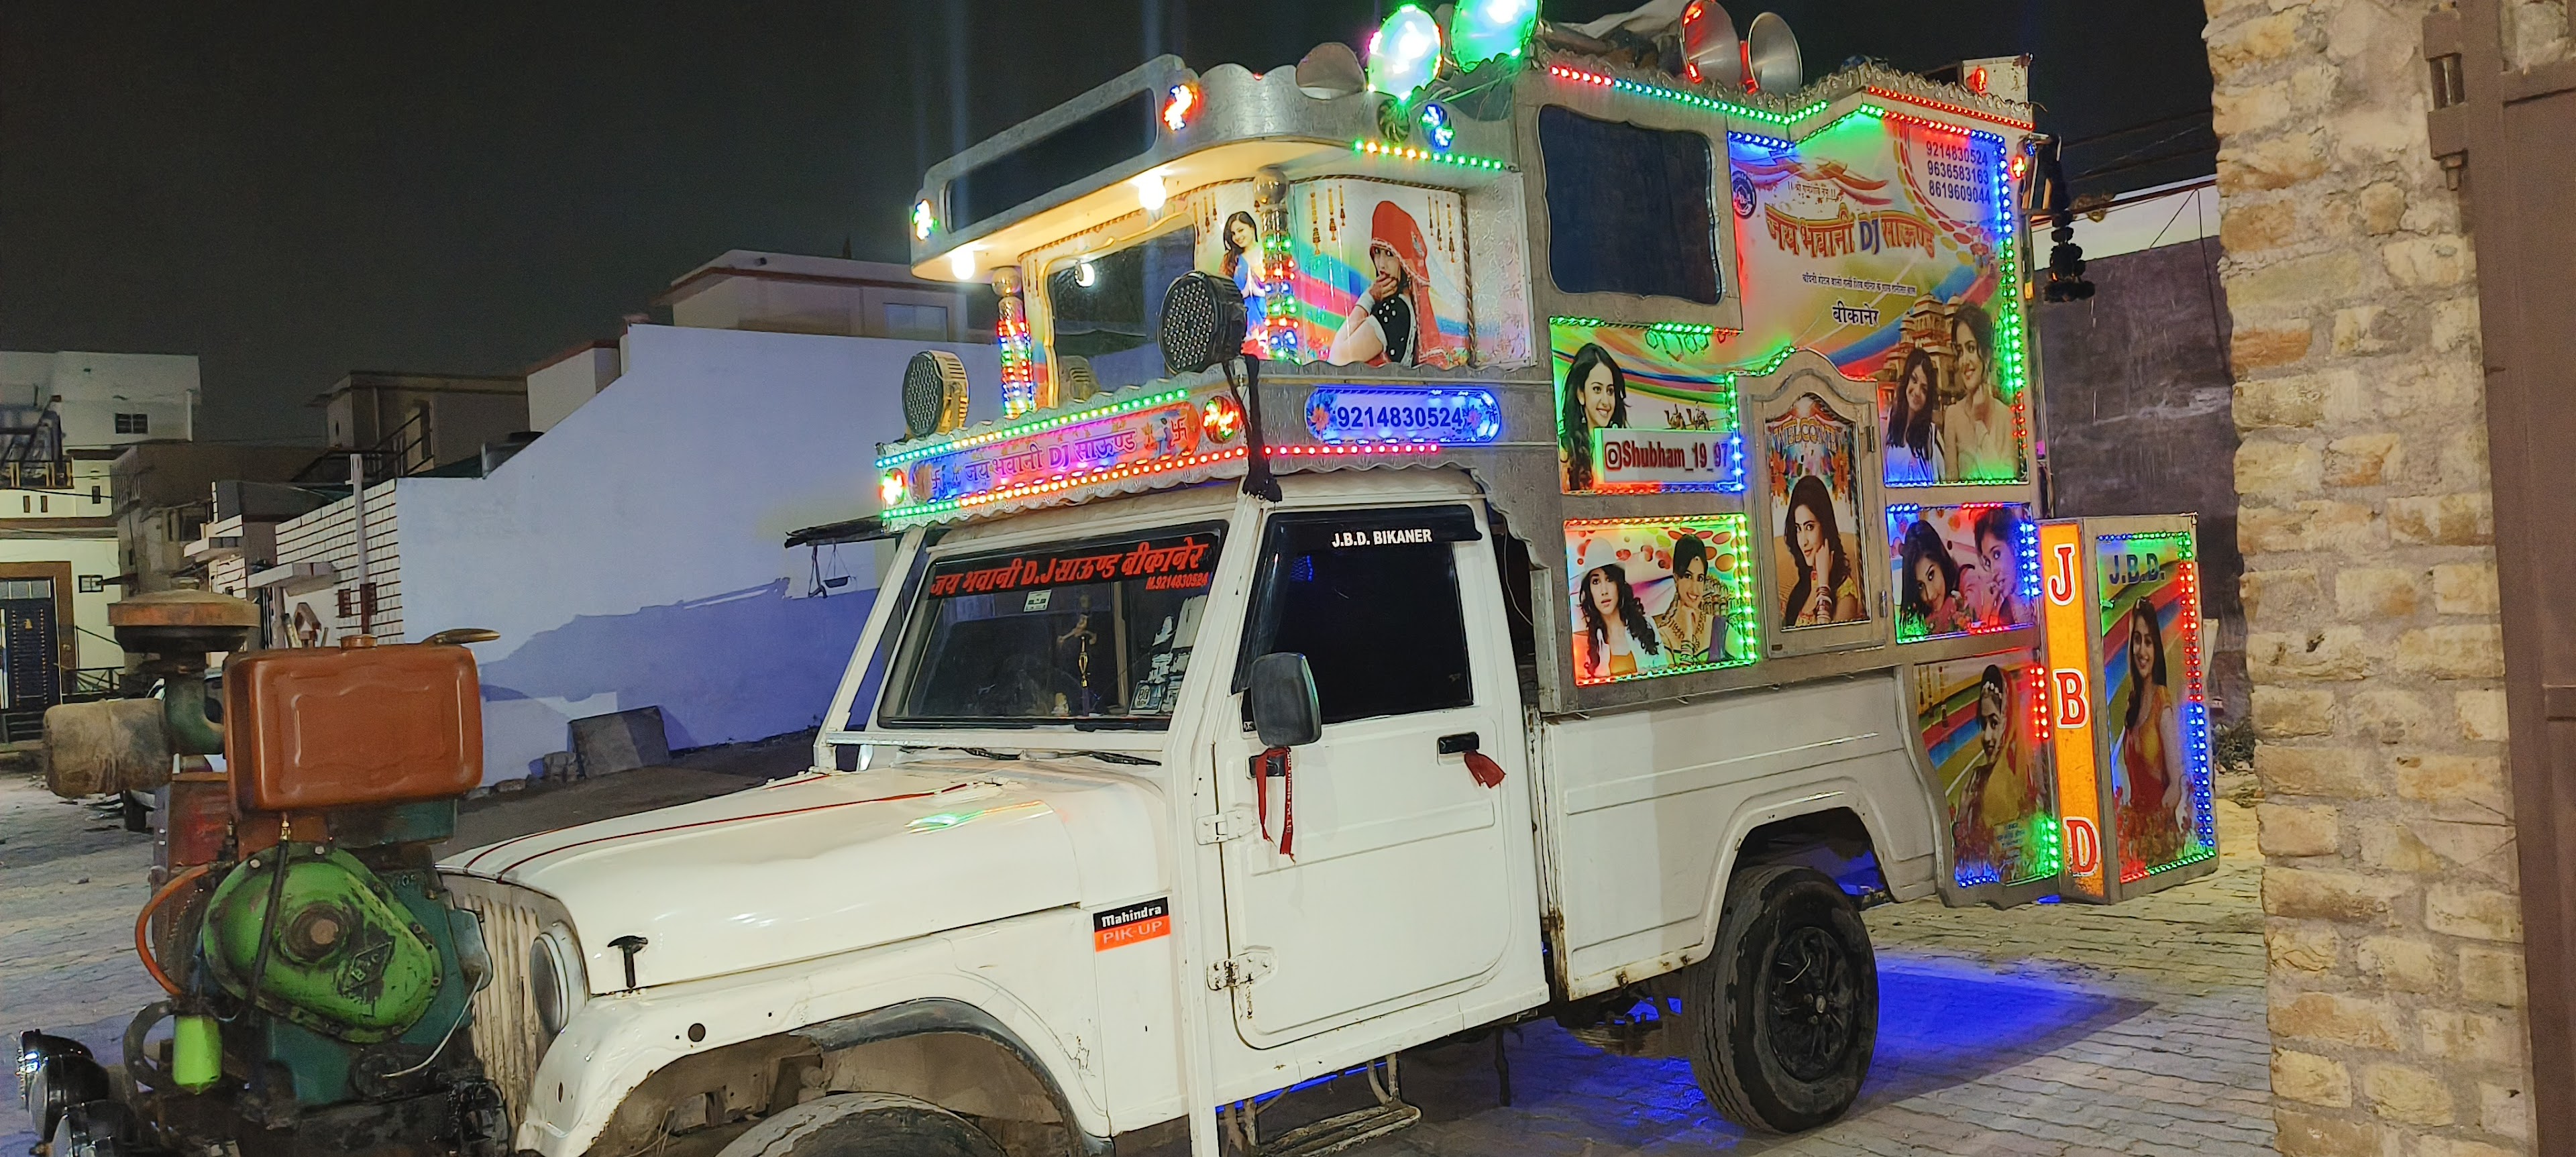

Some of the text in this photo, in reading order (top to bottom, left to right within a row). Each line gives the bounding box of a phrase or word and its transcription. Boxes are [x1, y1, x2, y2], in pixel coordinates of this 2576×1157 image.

[1927, 141, 1988, 166] 9214830524
[1927, 160, 1989, 185] 9636583163
[1929, 180, 1991, 205] 8619609044
[1764, 203, 1799, 256] जय
[1800, 202, 1856, 258] भवानी
[1859, 215, 1880, 256] DJ
[1833, 301, 1879, 327] बीकानेर
[1338, 407, 1463, 428] 9214830524
[1774, 418, 1837, 453] WELCOME
[965, 460, 990, 482] जय
[993, 443, 1043, 475] भवानी
[1049, 443, 1070, 470] DJ
[1332, 529, 1432, 547] J.B.D. BIKANER
[930, 573, 963, 596] जय
[963, 559, 1024, 592] भवानी
[1122, 537, 1210, 575] बीकानेर
[2109, 553, 2165, 584] J.B.D.
[1102, 906, 1162, 928] Mahindra
[1104, 921, 1163, 944] PIK-UP
